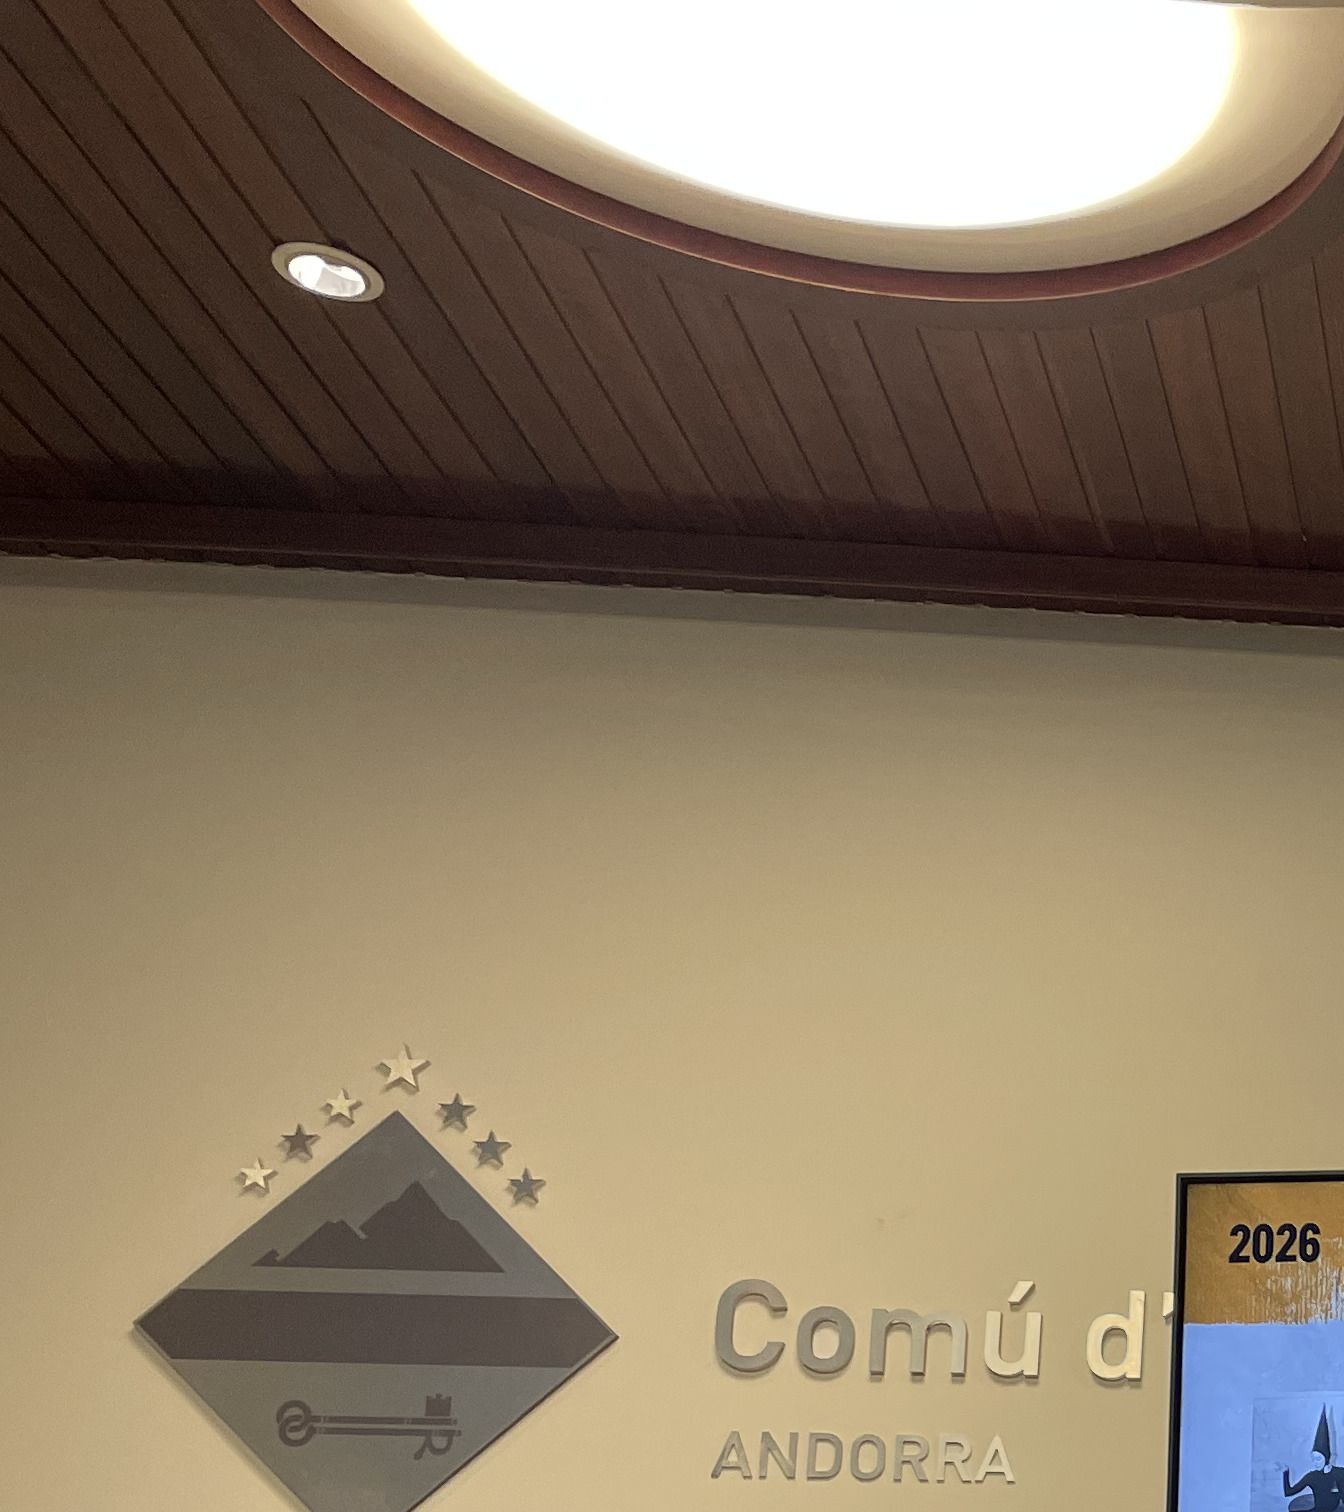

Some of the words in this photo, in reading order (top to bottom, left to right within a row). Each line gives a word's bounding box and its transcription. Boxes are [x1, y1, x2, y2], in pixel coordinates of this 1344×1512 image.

[1228, 1223, 1321, 1263] 2026
[714, 1279, 1043, 1379] Comú
[711, 1431, 1015, 1484] ANDORRA
